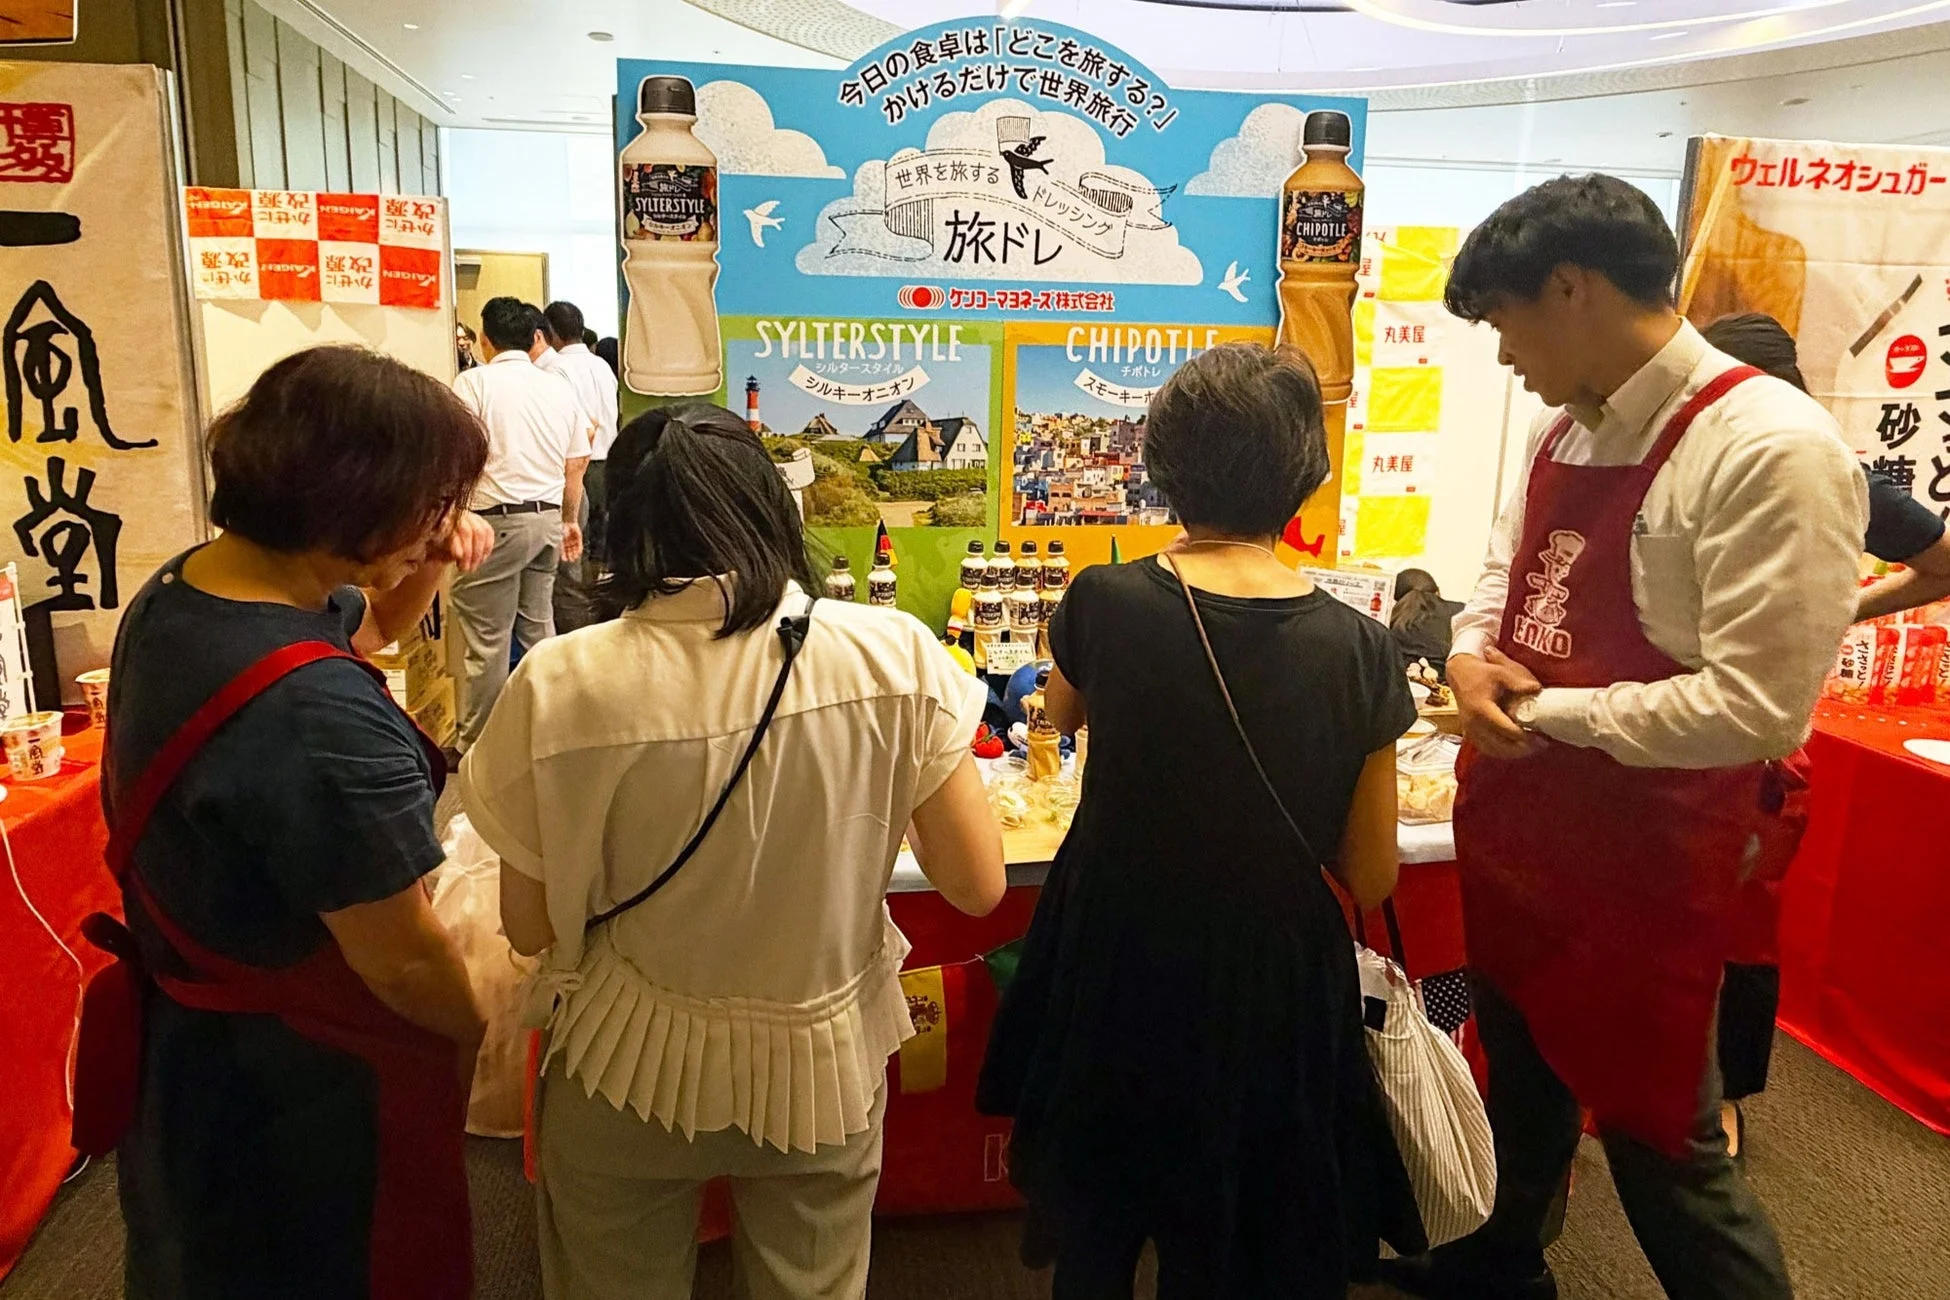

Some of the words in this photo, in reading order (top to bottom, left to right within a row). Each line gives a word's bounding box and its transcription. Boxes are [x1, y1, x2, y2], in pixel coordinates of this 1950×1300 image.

[884, 65, 1138, 136] かけるだけで世界旅行
[895, 160, 1000, 189] 世界を旅する
[1731, 153, 1947, 195] ウェルネオシュガー
[320, 204, 375, 220] KAIGEN
[386, 199, 436, 220] 改源
[635, 197, 705, 213] SYLTERSTYLE
[1032, 185, 1113, 236] ドレッシング
[258, 210, 311, 226] かぜに
[386, 218, 435, 236] かぜに
[944, 209, 1063, 265] 旅ドレ
[1296, 222, 1347, 237] CHIPOTLE
[201, 251, 250, 269] 改源
[326, 254, 373, 273] 改源
[260, 262, 316, 278] KAIGEN
[382, 269, 436, 287] KAIGEN
[325, 274, 373, 290] かぜに
[949, 288, 1113, 311] ケンコーマヨネーズ株式会社
[754, 320, 963, 362] SYLTERSTYLE
[1384, 325, 1426, 344] 丸美屋
[815, 361, 904, 375] シルタースタイル
[804, 375, 915, 402] シルキーオニオン
[0, 211, 158, 610] 一風堂
[1372, 455, 1414, 473] 丸美屋
